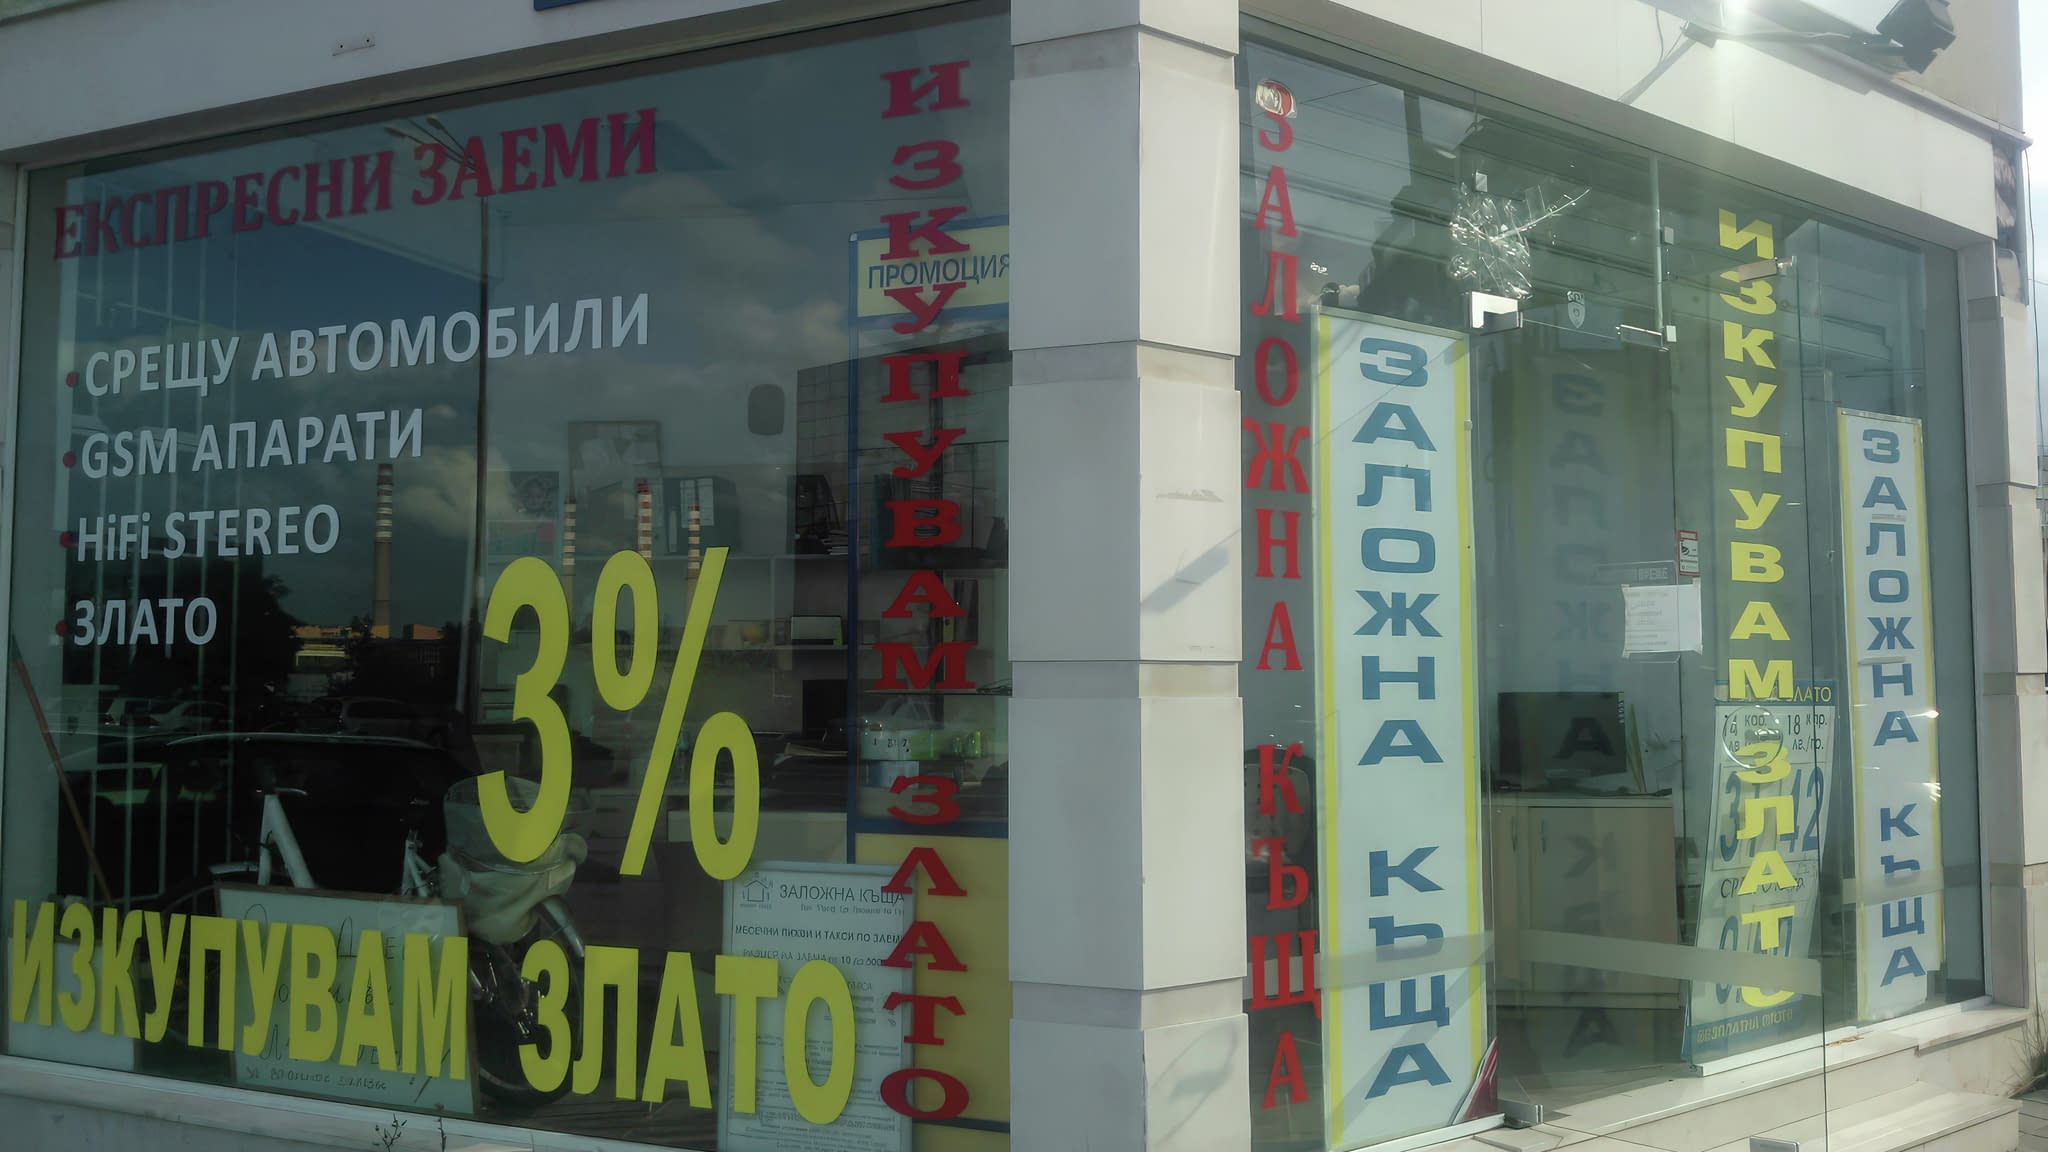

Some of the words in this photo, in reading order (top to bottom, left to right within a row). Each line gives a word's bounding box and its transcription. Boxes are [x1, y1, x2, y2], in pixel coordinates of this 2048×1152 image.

[53, 151, 394, 260] ЕКСПРЕСНИ
[411, 107, 658, 206] ЗАЕМИ
[85, 335, 241, 396] СРЕЩУ
[251, 293, 650, 382] АВТОМОБИЛИ
[868, 253, 1009, 289] ПРОМОЦИЯ
[81, 427, 178, 479] GSM
[192, 407, 424, 472] АПАРАТИ
[873, 60, 977, 690] ИЗКУПУВАМ
[1242, 80, 1312, 672] ЗАЛОЖНА
[1718, 207, 1793, 699] ИЗКУПУВАМ
[77, 516, 150, 562] HiFi
[164, 503, 341, 561] STEREO
[1351, 338, 1445, 766] ЗАЛОЖНА
[1862, 428, 1920, 747] ЗАЛОЖНА
[74, 596, 218, 647] ЗЛАТО
[1791, 685, 1832, 702] ЛАТО
[477, 547, 760, 881] 3%
[1787, 713, 1801, 736] 18
[779, 884, 855, 902] ЗАЛОЖНА
[859, 887, 905, 906] КЪЩА
[840, 953, 851, 965] 10
[856, 931, 871, 943] ПО
[873, 933, 902, 945] ЗАЕМ
[880, 775, 970, 1121] ЗЛАТО
[1248, 742, 1322, 1110] КЪЩА
[1365, 845, 1452, 1100] КЪЩА
[1880, 803, 1927, 988] КЪЩА
[10, 898, 468, 1081] ИЗКУПУВАМ
[518, 939, 856, 1125] ЗЛАТО
